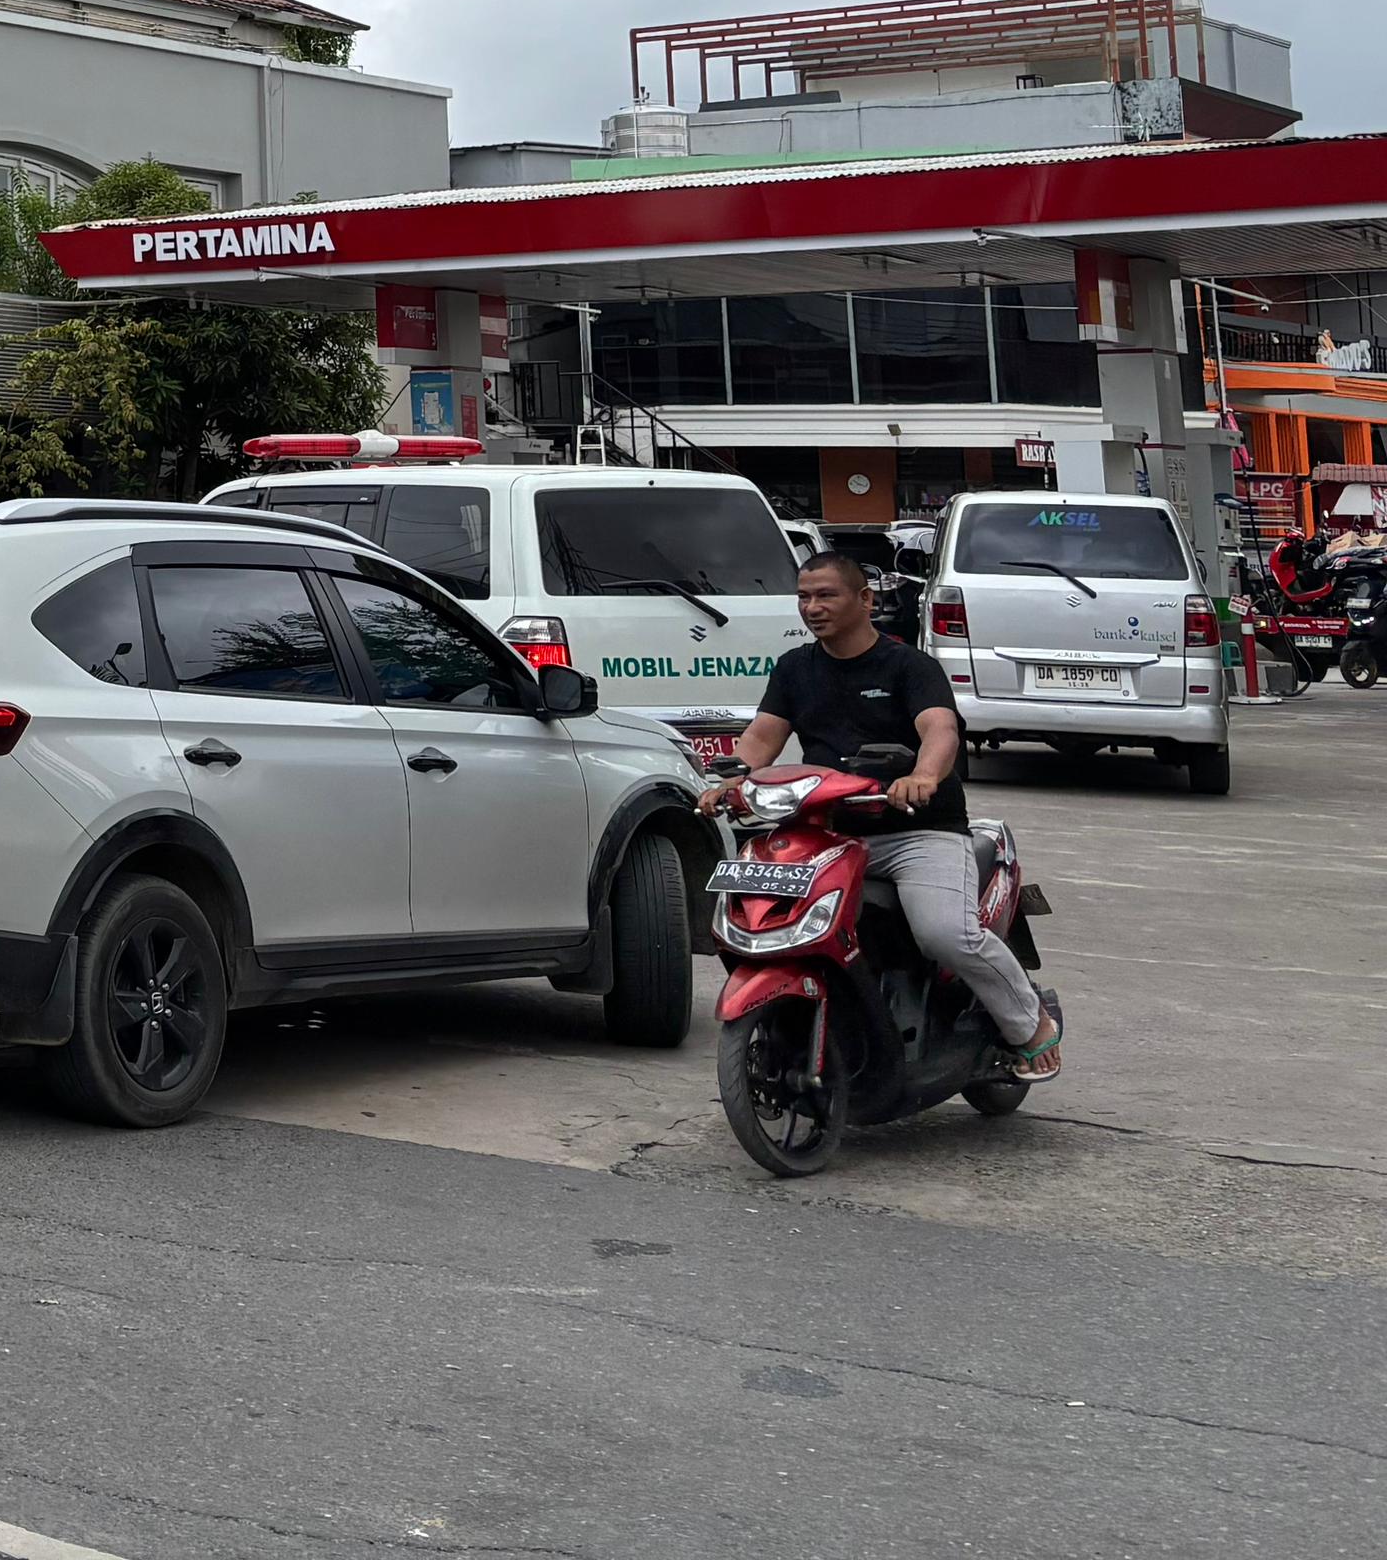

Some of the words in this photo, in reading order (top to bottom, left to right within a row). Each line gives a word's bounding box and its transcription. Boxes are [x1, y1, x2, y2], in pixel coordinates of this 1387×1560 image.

[132, 221, 336, 263] PERTAMINA
[1249, 480, 1285, 497] LPG
[1028, 509, 1101, 527] AKSEL
[1093, 627, 1127, 641] bank
[1139, 630, 1177, 642] kalsel
[602, 656, 680, 678] MOBIL
[687, 656, 777, 678] JENAZA
[1037, 666, 1055, 681] DA
[1061, 667, 1094, 682] 1859
[716, 863, 736, 878] DA
[745, 864, 784, 879] 6346
[793, 867, 815, 881] SZ
